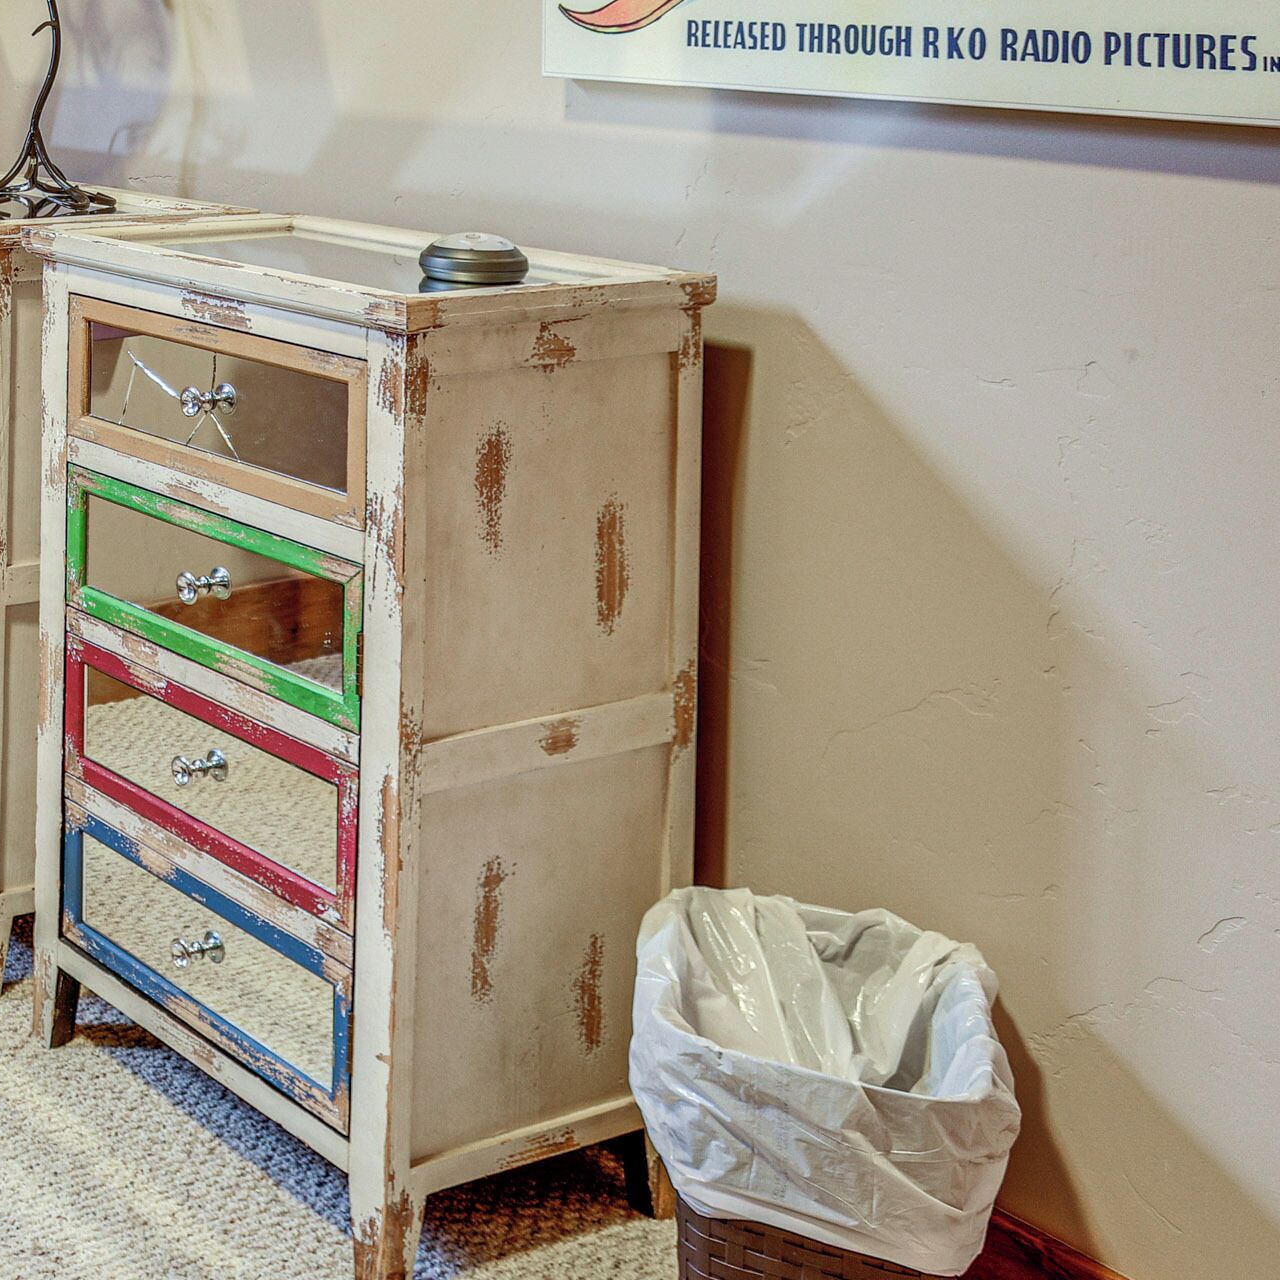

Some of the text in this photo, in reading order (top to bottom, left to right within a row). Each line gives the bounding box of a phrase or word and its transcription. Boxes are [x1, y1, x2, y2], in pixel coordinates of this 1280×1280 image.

[686, 19, 787, 52] RELEASED
[795, 22, 912, 58] THROUGH
[1000, 28, 1092, 65] RADIO
[1103, 31, 1257, 72] PICTURES
